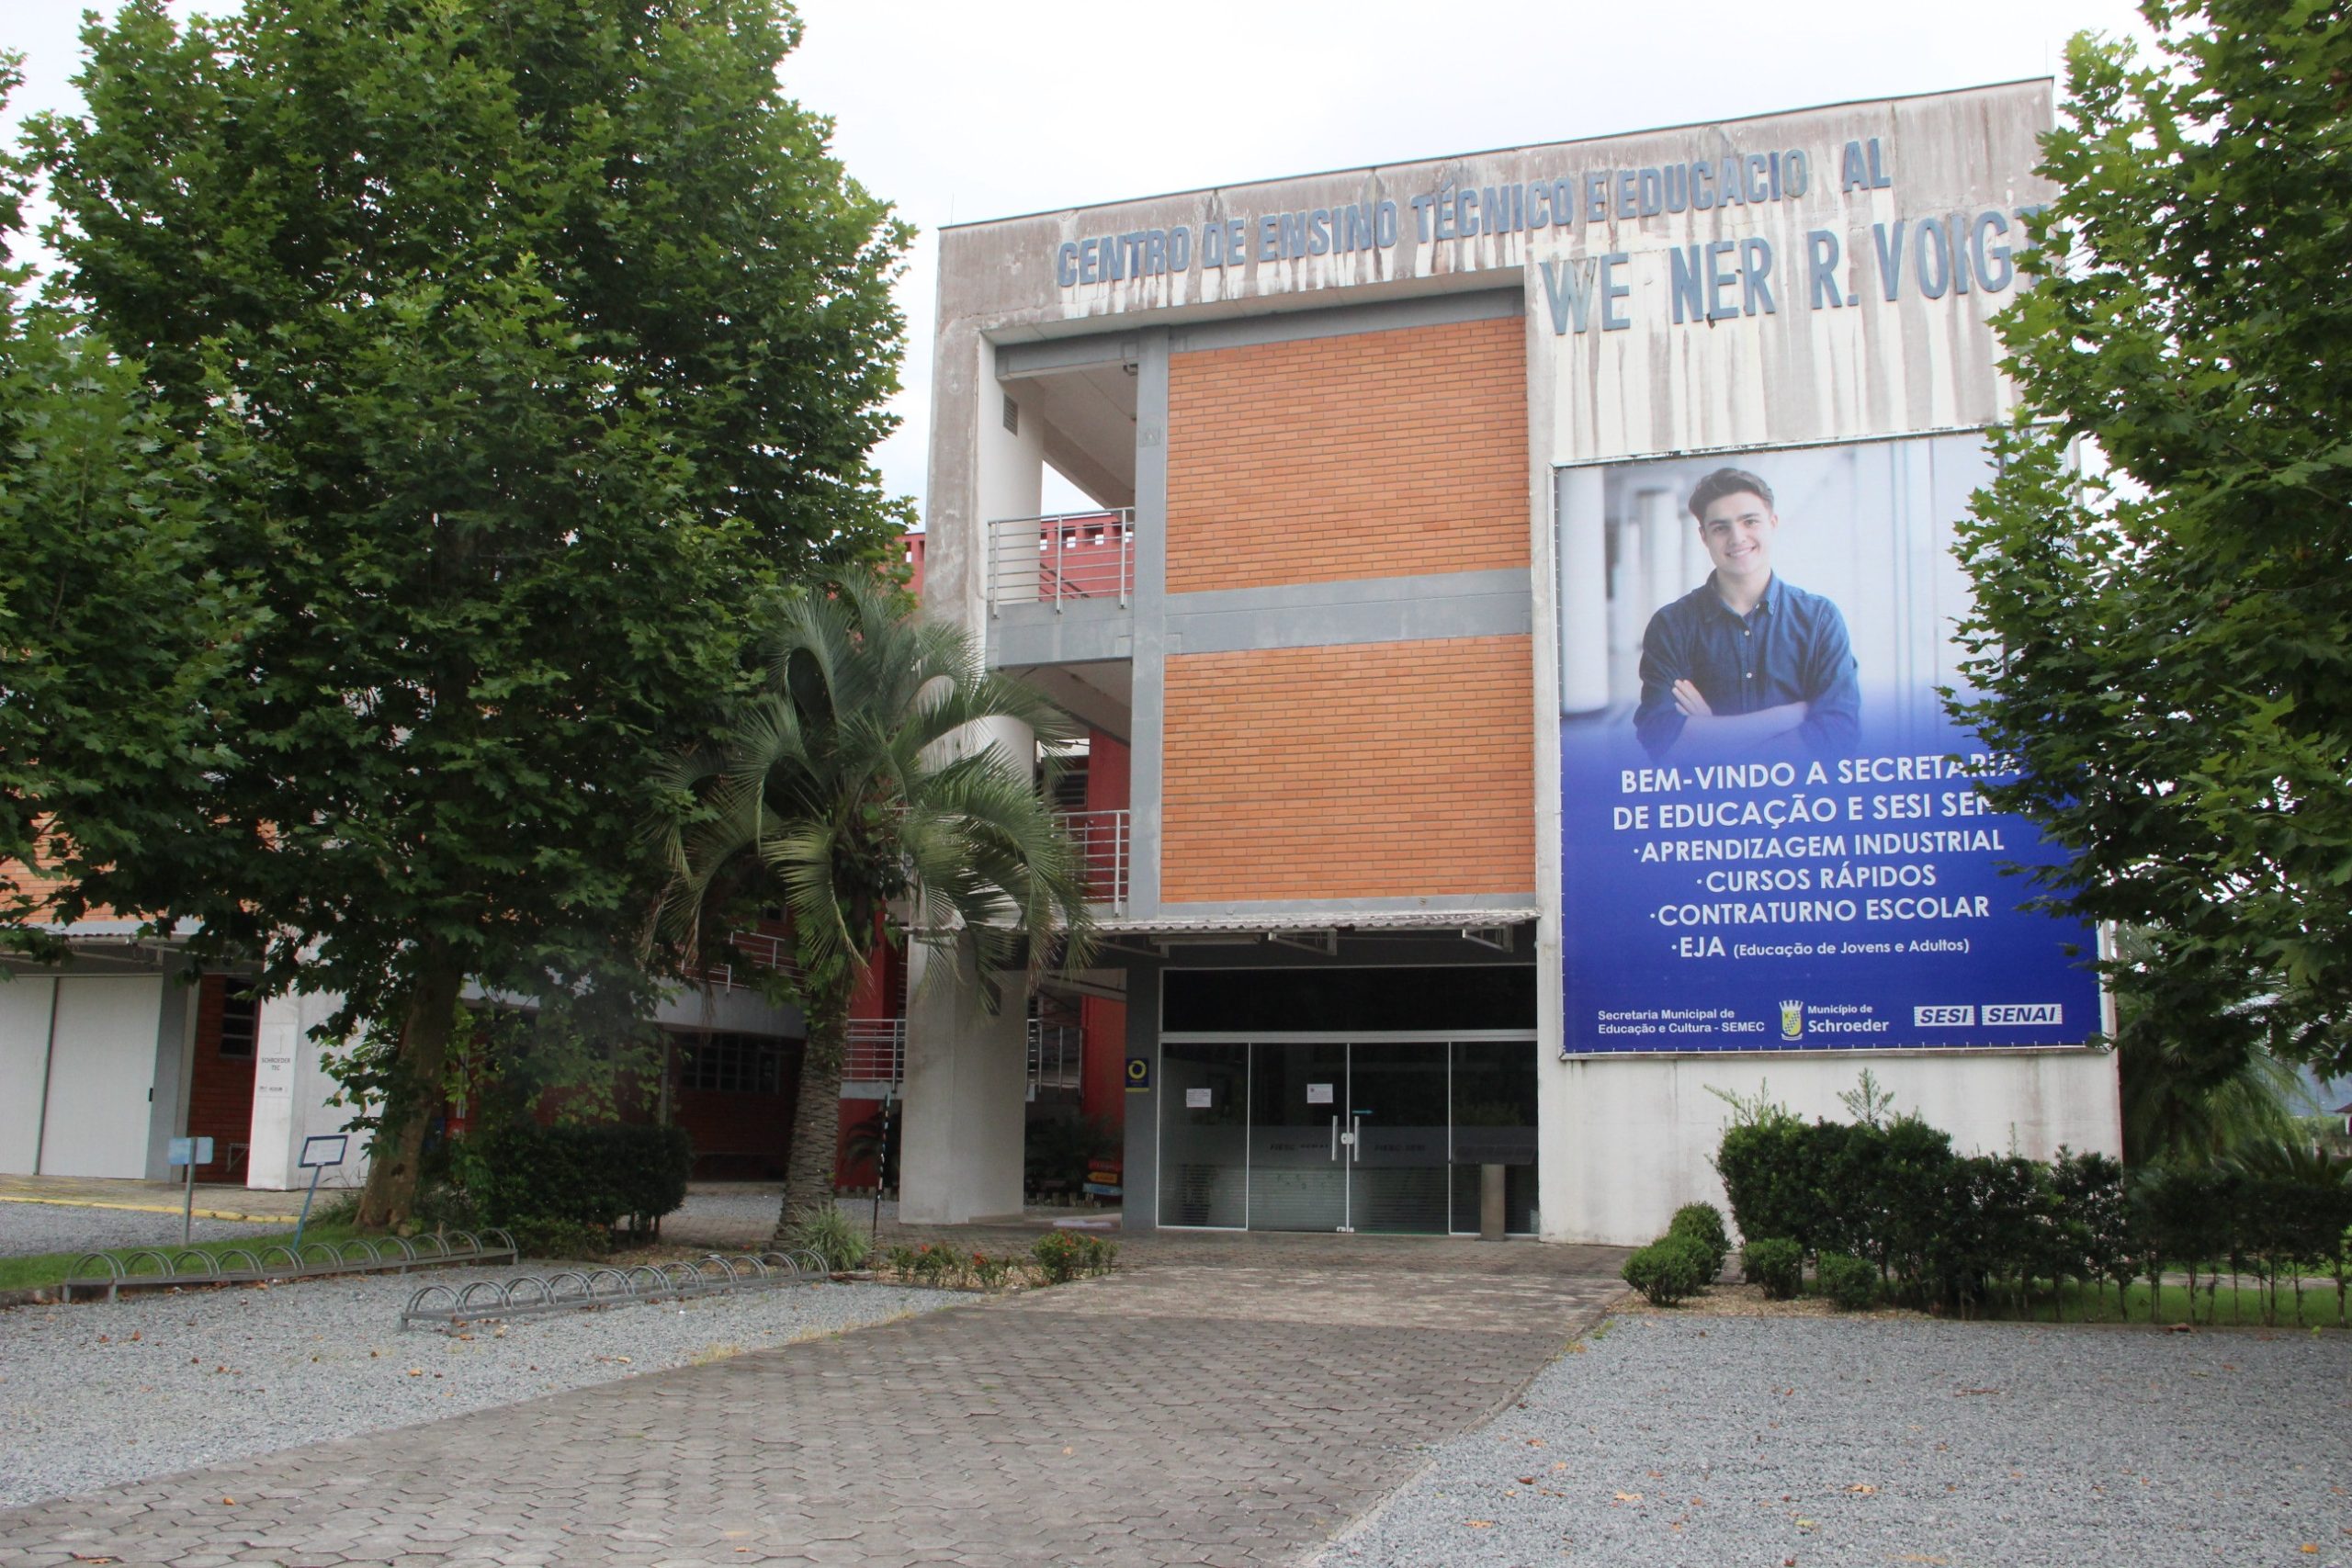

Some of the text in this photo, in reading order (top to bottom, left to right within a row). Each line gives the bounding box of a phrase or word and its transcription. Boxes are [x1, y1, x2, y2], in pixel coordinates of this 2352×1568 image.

[1057, 225, 1192, 288] CENTRO
[1202, 217, 1246, 270] DE
[1258, 199, 1398, 263] ENSINO
[1410, 175, 1575, 244] TÉCNICO
[1586, 170, 1608, 223] E
[1805, 229, 1860, 310] R.
[1621, 752, 2021, 794] BEM-VINDO A SECRETARIA
[1612, 806, 1650, 830] DE
[1659, 794, 1837, 829] EDUCAÇÃO
[1848, 796, 1863, 821] E
[1872, 793, 1931, 820] SESI
[1854, 829, 2005, 855] INDUSTRIAL
[1819, 861, 1937, 889] RÁPIDOS
[1866, 896, 1990, 920] ESCOLAR
[1733, 942, 1814, 959] (Educação
[1816, 942, 1837, 954] de
[1840, 942, 1891, 954] Jovens
[1894, 942, 1905, 953] e
[1908, 938, 1970, 953] Adultos)
[1598, 1008, 1736, 1021] Secretaria Municipal de
[1807, 1003, 1872, 1016] Município de
[1919, 1008, 1969, 1024] SESI
[1987, 1006, 2056, 1022] SENAI
[1598, 1022, 1655, 1036] Educação
[1658, 1025, 1666, 1033] e
[1668, 1021, 1712, 1033] Cultura
[1721, 1021, 1765, 1032] SEMEC
[1807, 1018, 1890, 1033] Schroeder
